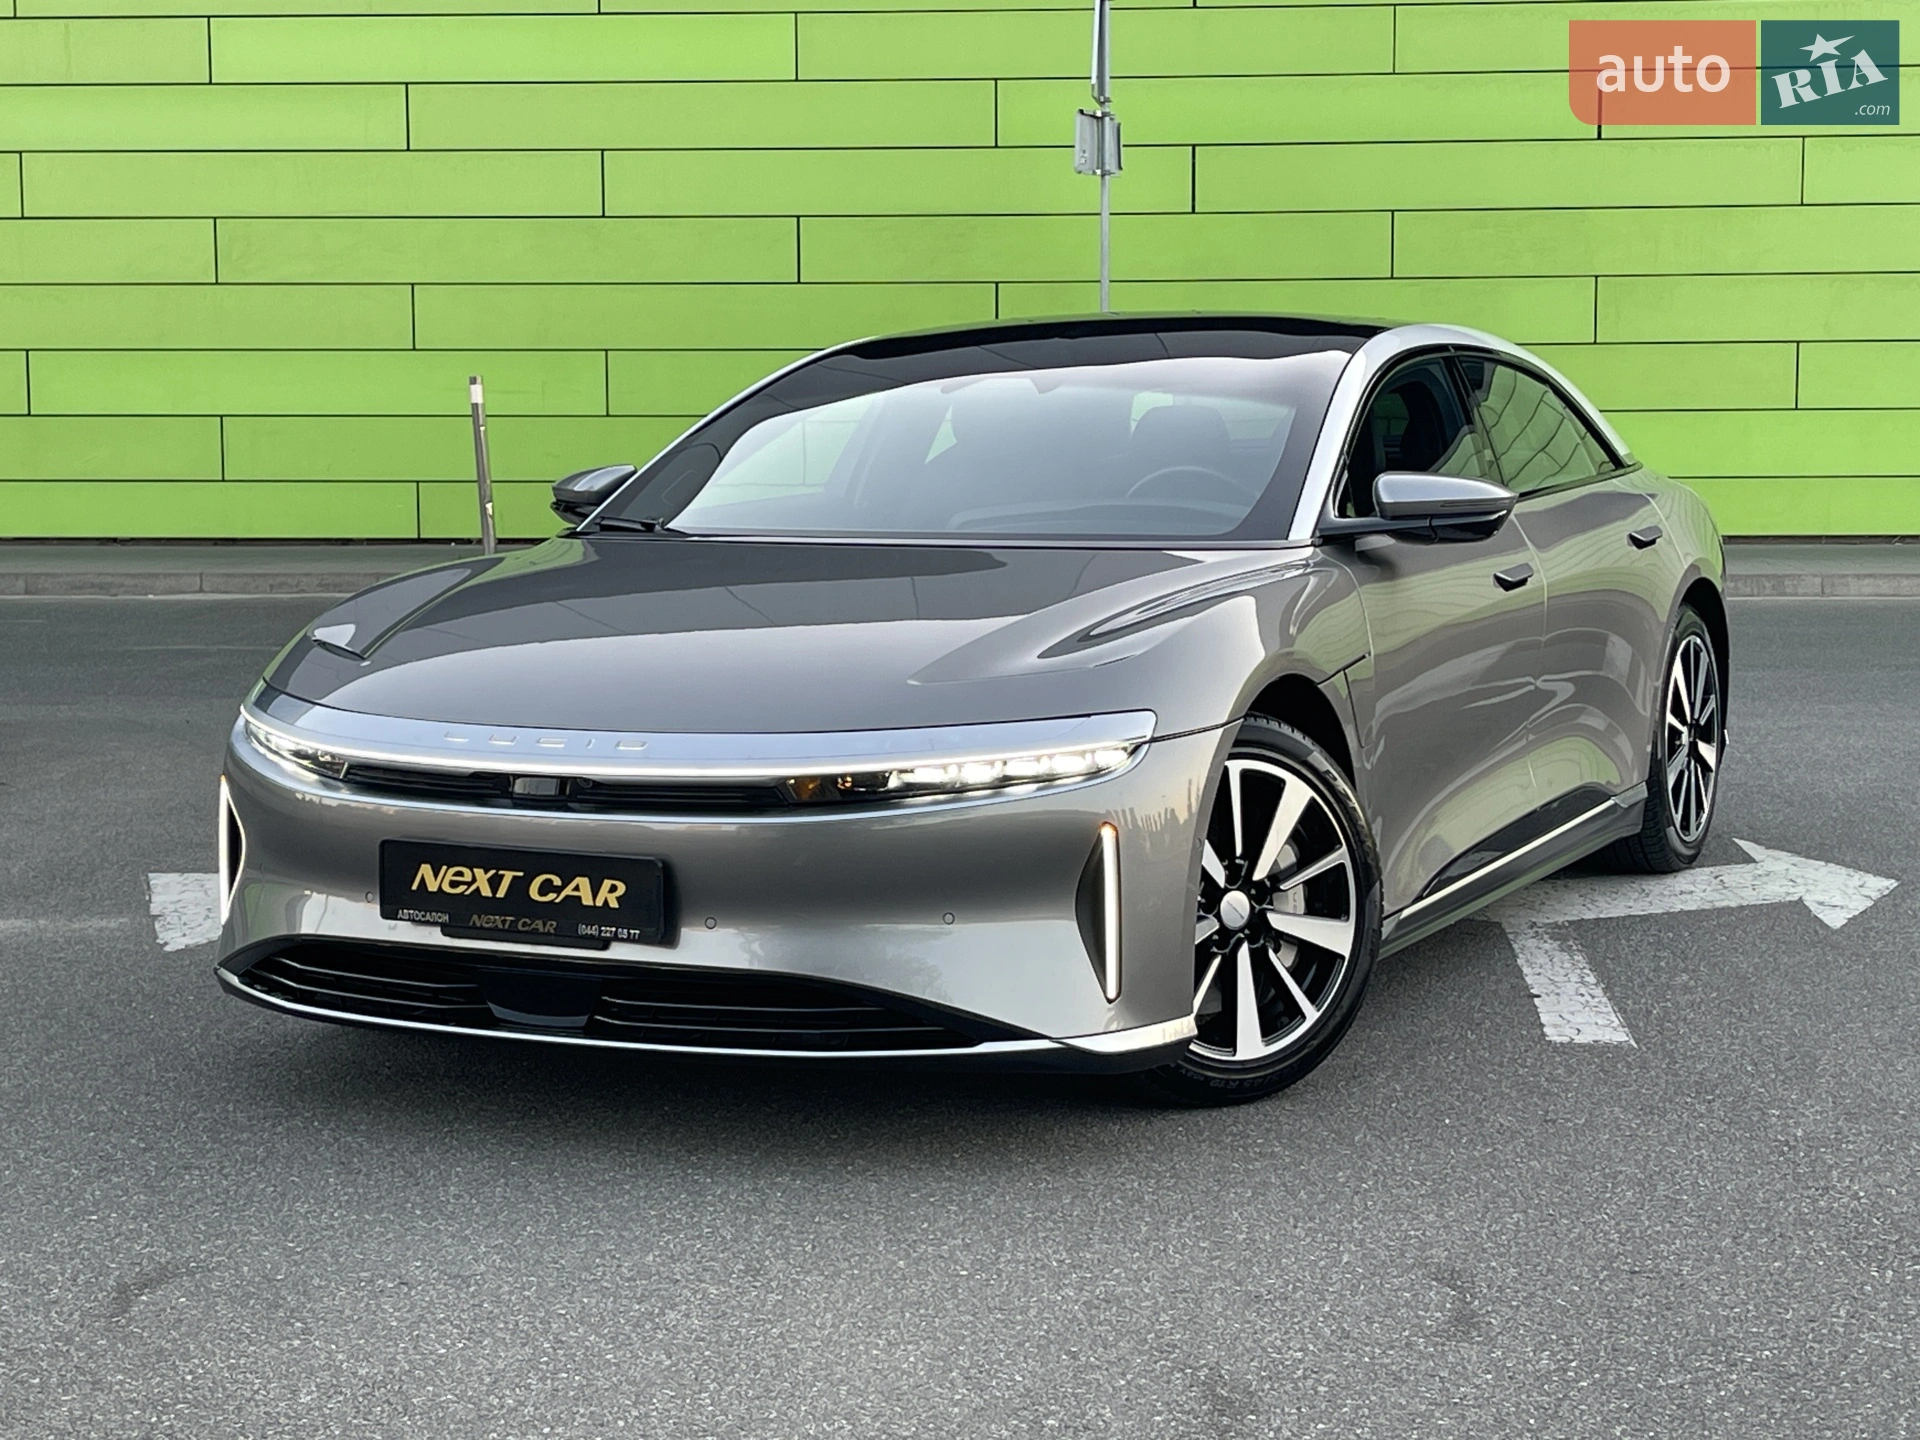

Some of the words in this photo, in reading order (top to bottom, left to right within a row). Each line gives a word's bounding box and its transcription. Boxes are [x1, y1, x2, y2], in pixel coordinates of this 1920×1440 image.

[444, 731, 648, 751] LUCID
[530, 873, 626, 909] CAR
[397, 909, 449, 923] АВТОСАЛОН
[517, 917, 557, 934] CAR
[578, 923, 599, 937] (044)
[600, 926, 616, 937] 227
[629, 930, 640, 940] 77
